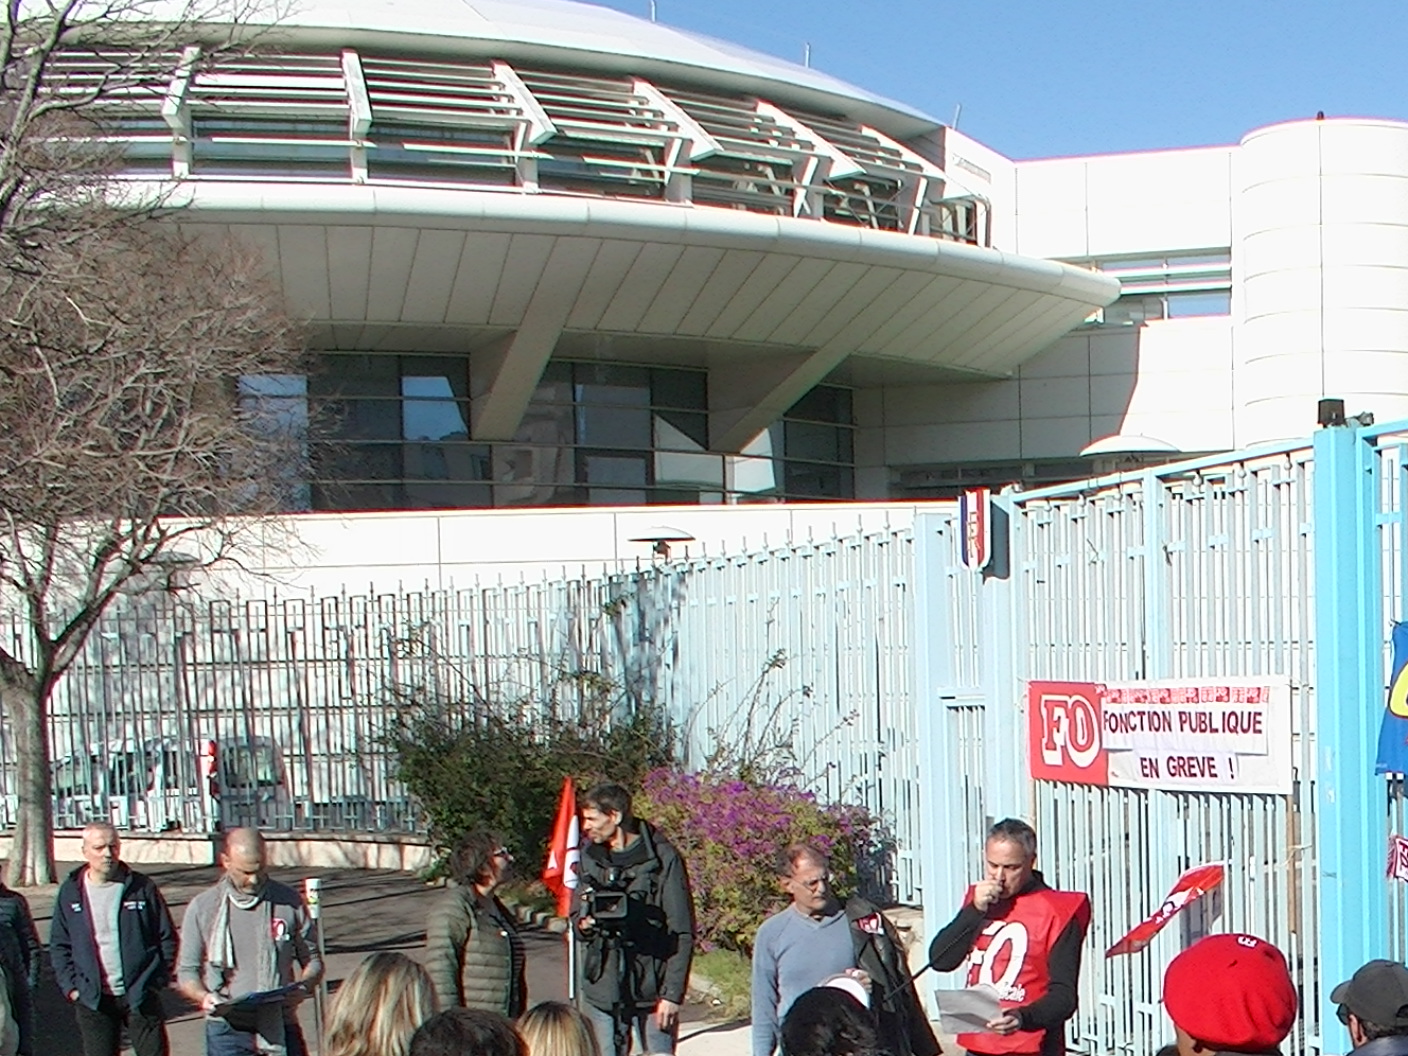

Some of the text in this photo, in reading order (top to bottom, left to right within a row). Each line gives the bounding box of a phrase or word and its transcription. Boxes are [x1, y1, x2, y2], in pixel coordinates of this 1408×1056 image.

[1040, 694, 1100, 768] FO
[1103, 710, 1172, 733] FONCTION
[1178, 711, 1263, 735] PUBLIQUE
[1141, 757, 1159, 779] EN
[1166, 756, 1218, 778] GREVE
